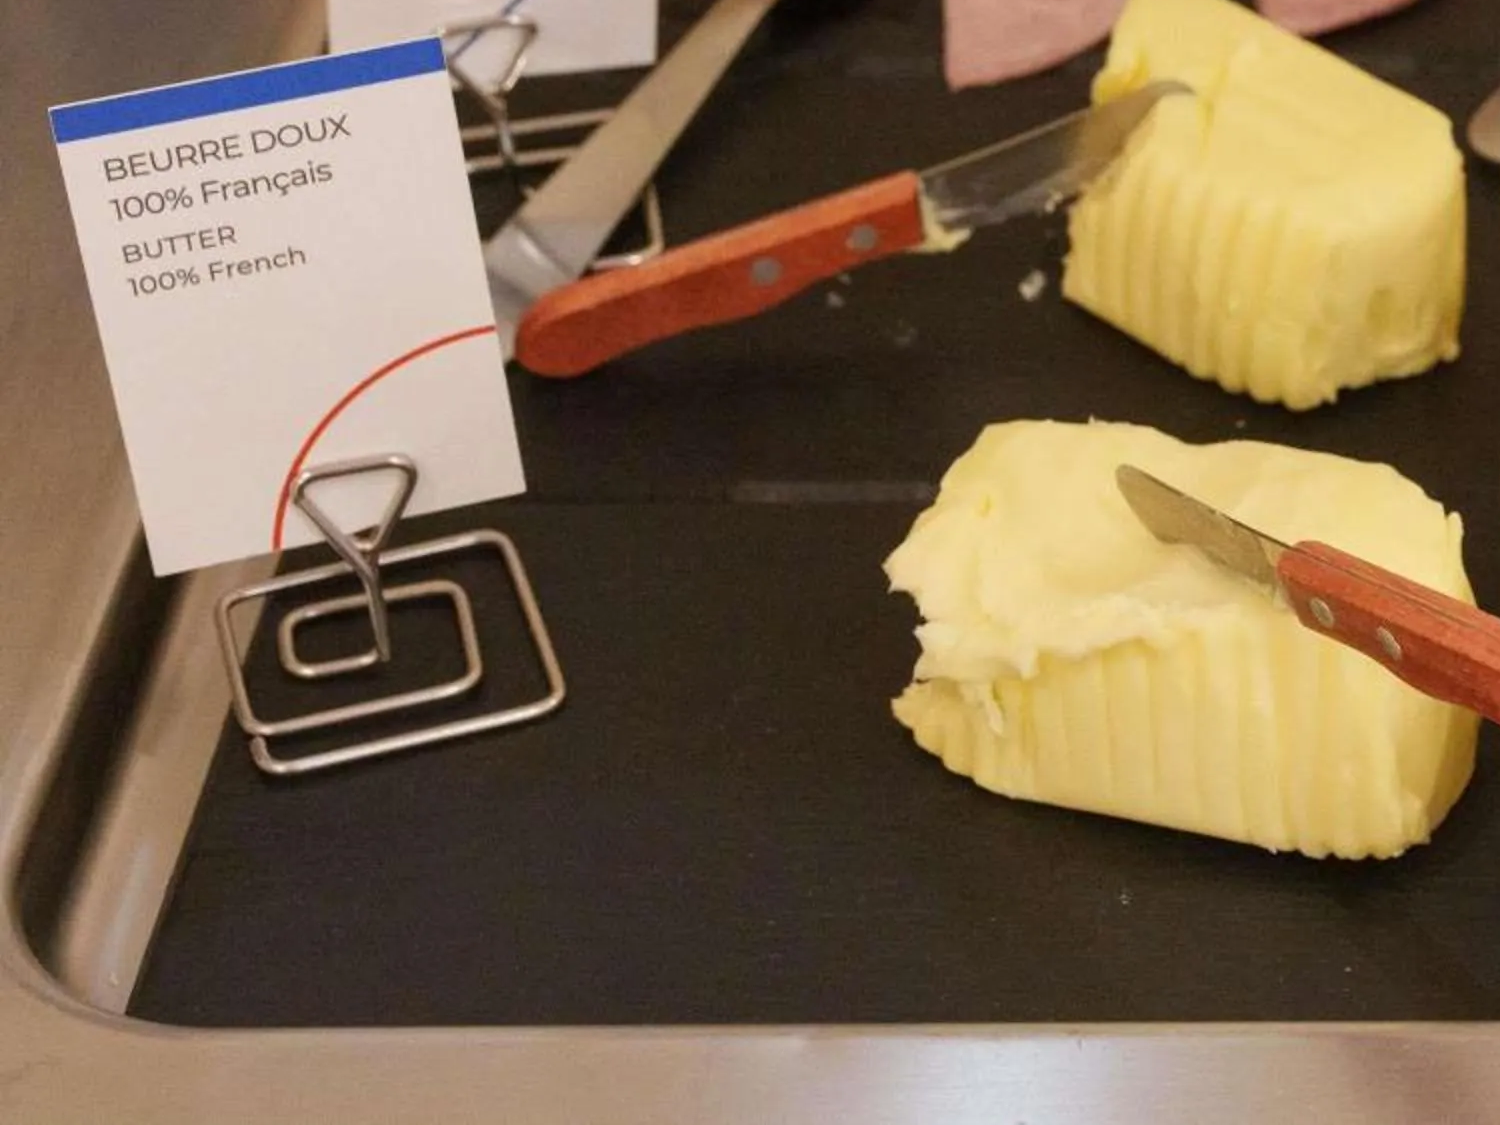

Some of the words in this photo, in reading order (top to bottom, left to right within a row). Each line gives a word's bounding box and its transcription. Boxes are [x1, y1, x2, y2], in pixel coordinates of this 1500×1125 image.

[103, 135, 243, 182] BEURRE
[250, 114, 351, 154] DOUX
[108, 186, 194, 222] 100%
[200, 159, 333, 204] Français
[122, 225, 237, 264] BUTTER
[127, 266, 201, 298] 100%
[207, 246, 307, 282] French
